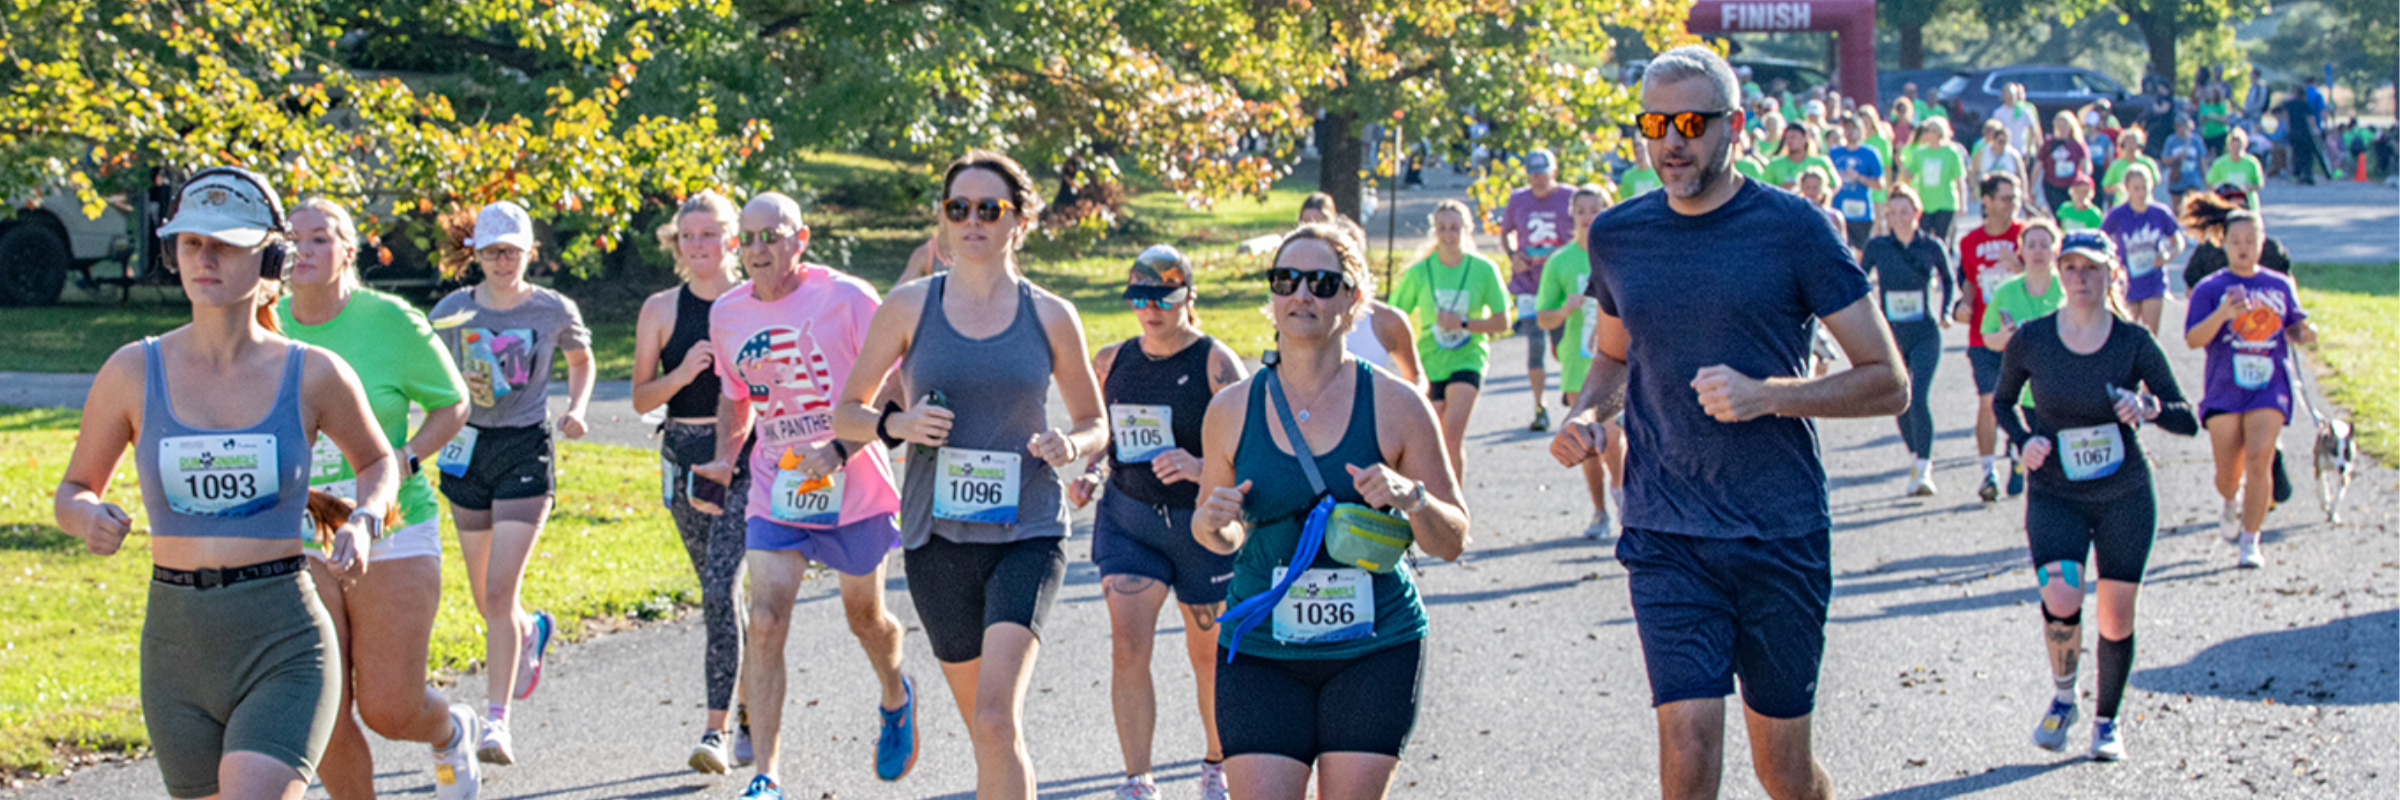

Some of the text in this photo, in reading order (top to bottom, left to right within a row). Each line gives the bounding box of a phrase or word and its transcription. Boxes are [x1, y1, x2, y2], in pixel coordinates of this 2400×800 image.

[1721, 2, 1811, 30] FINISH
[1527, 218, 1558, 243] 25
[779, 413, 833, 439] PANTHE
[1121, 428, 1162, 447] 1105
[2074, 447, 2111, 466] 1067
[185, 473, 257, 500] 1093
[950, 480, 1002, 504] 1096
[786, 490, 829, 511] 1070
[1293, 602, 1355, 625] 1036
